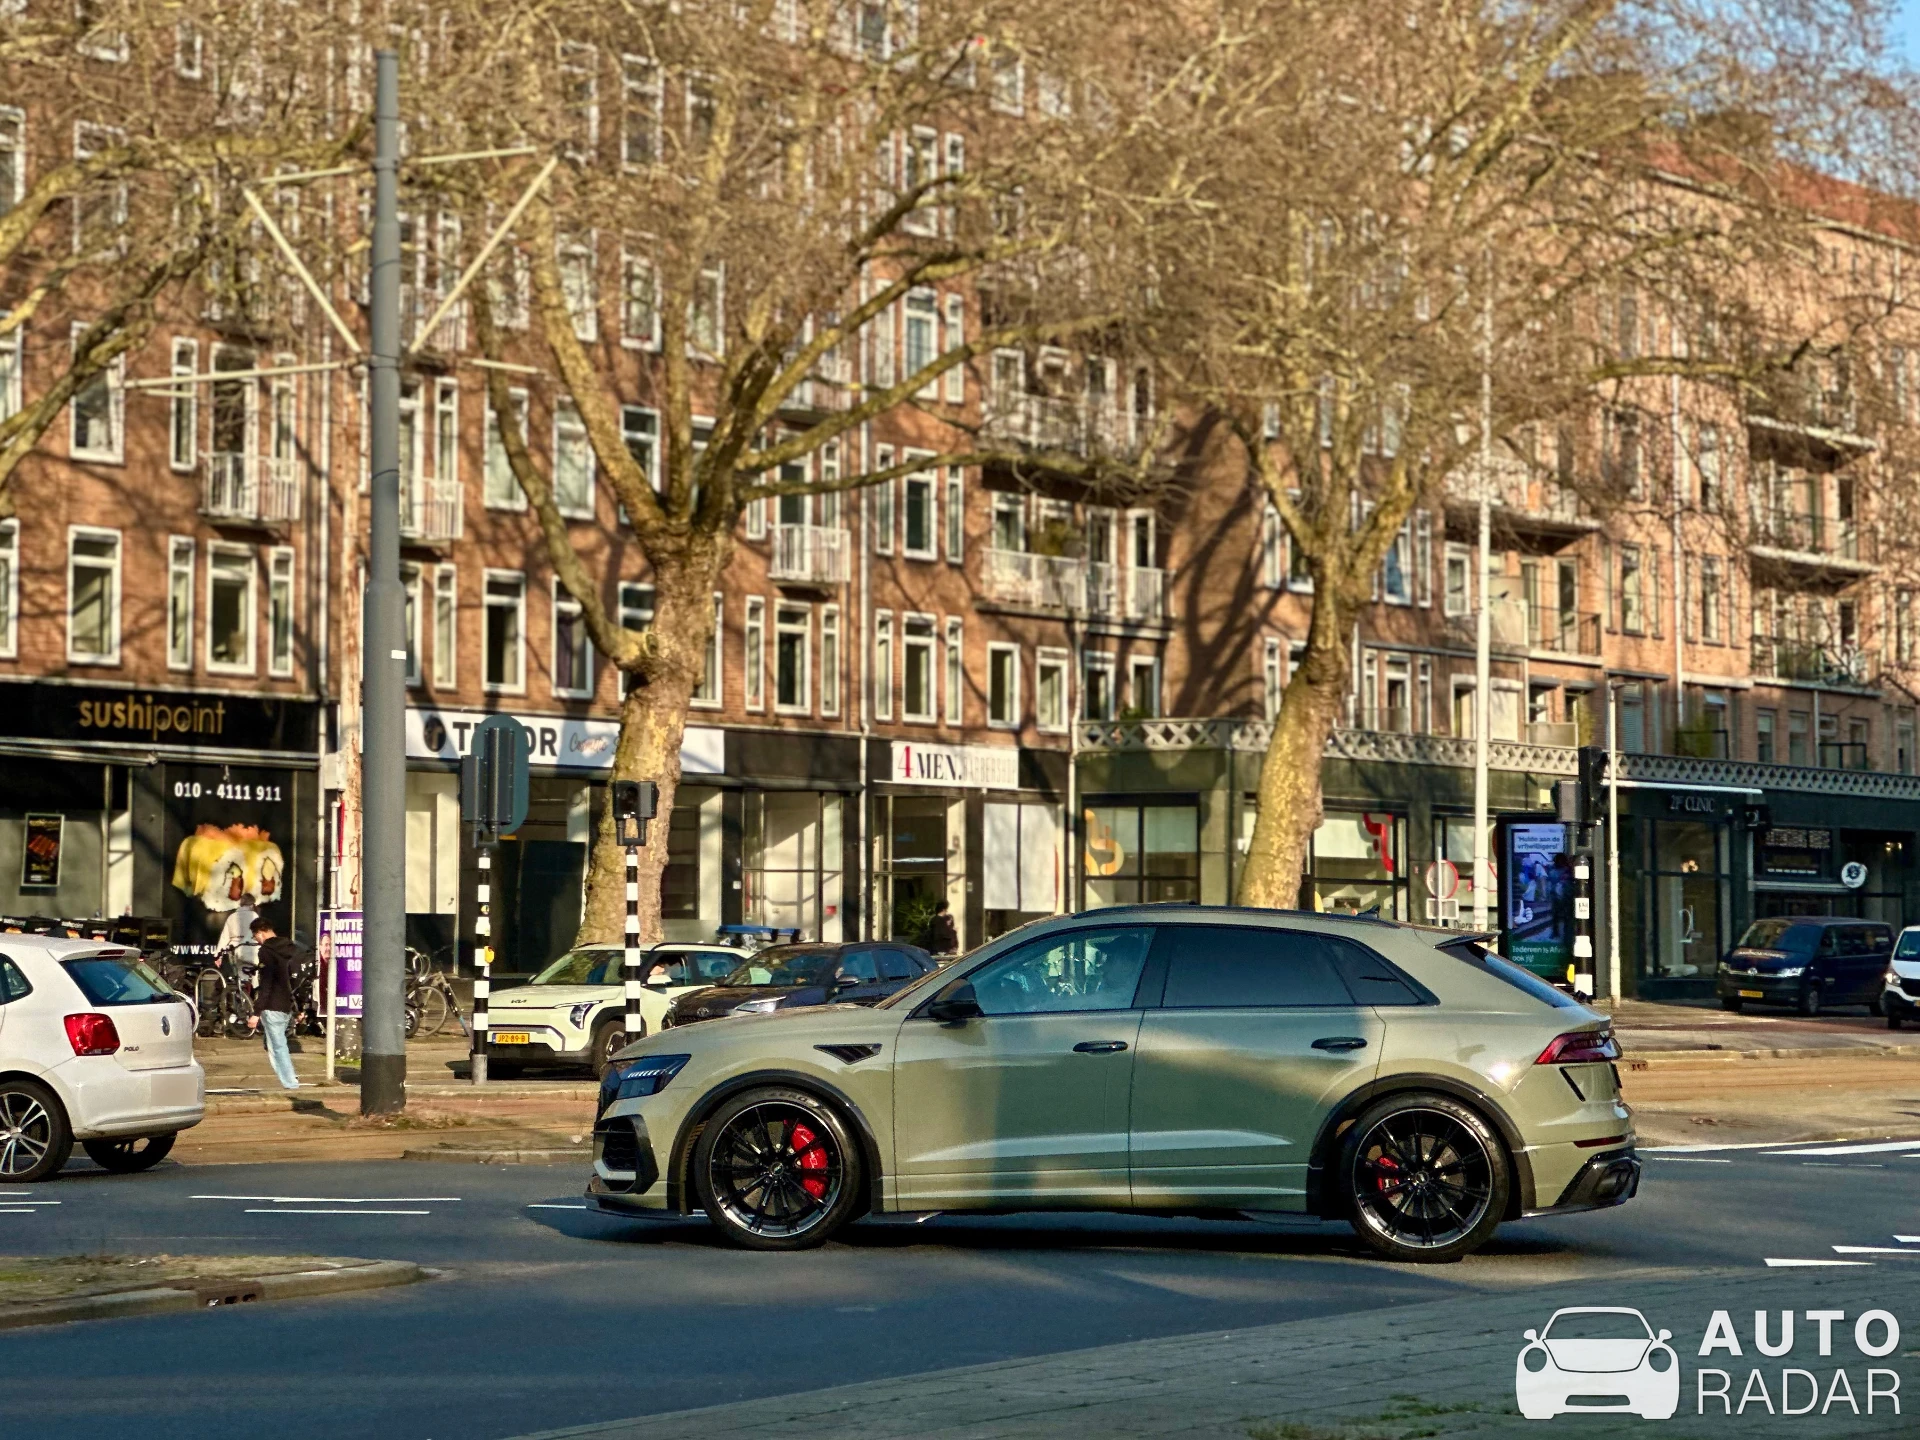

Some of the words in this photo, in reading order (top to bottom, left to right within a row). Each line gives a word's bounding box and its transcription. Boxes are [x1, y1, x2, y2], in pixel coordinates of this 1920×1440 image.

[79, 695, 225, 741] sushipoint
[898, 745, 913, 778] 4
[916, 752, 962, 781] MEN.
[174, 781, 201, 797] 010
[217, 784, 251, 800] 4111
[256, 786, 281, 801] 911
